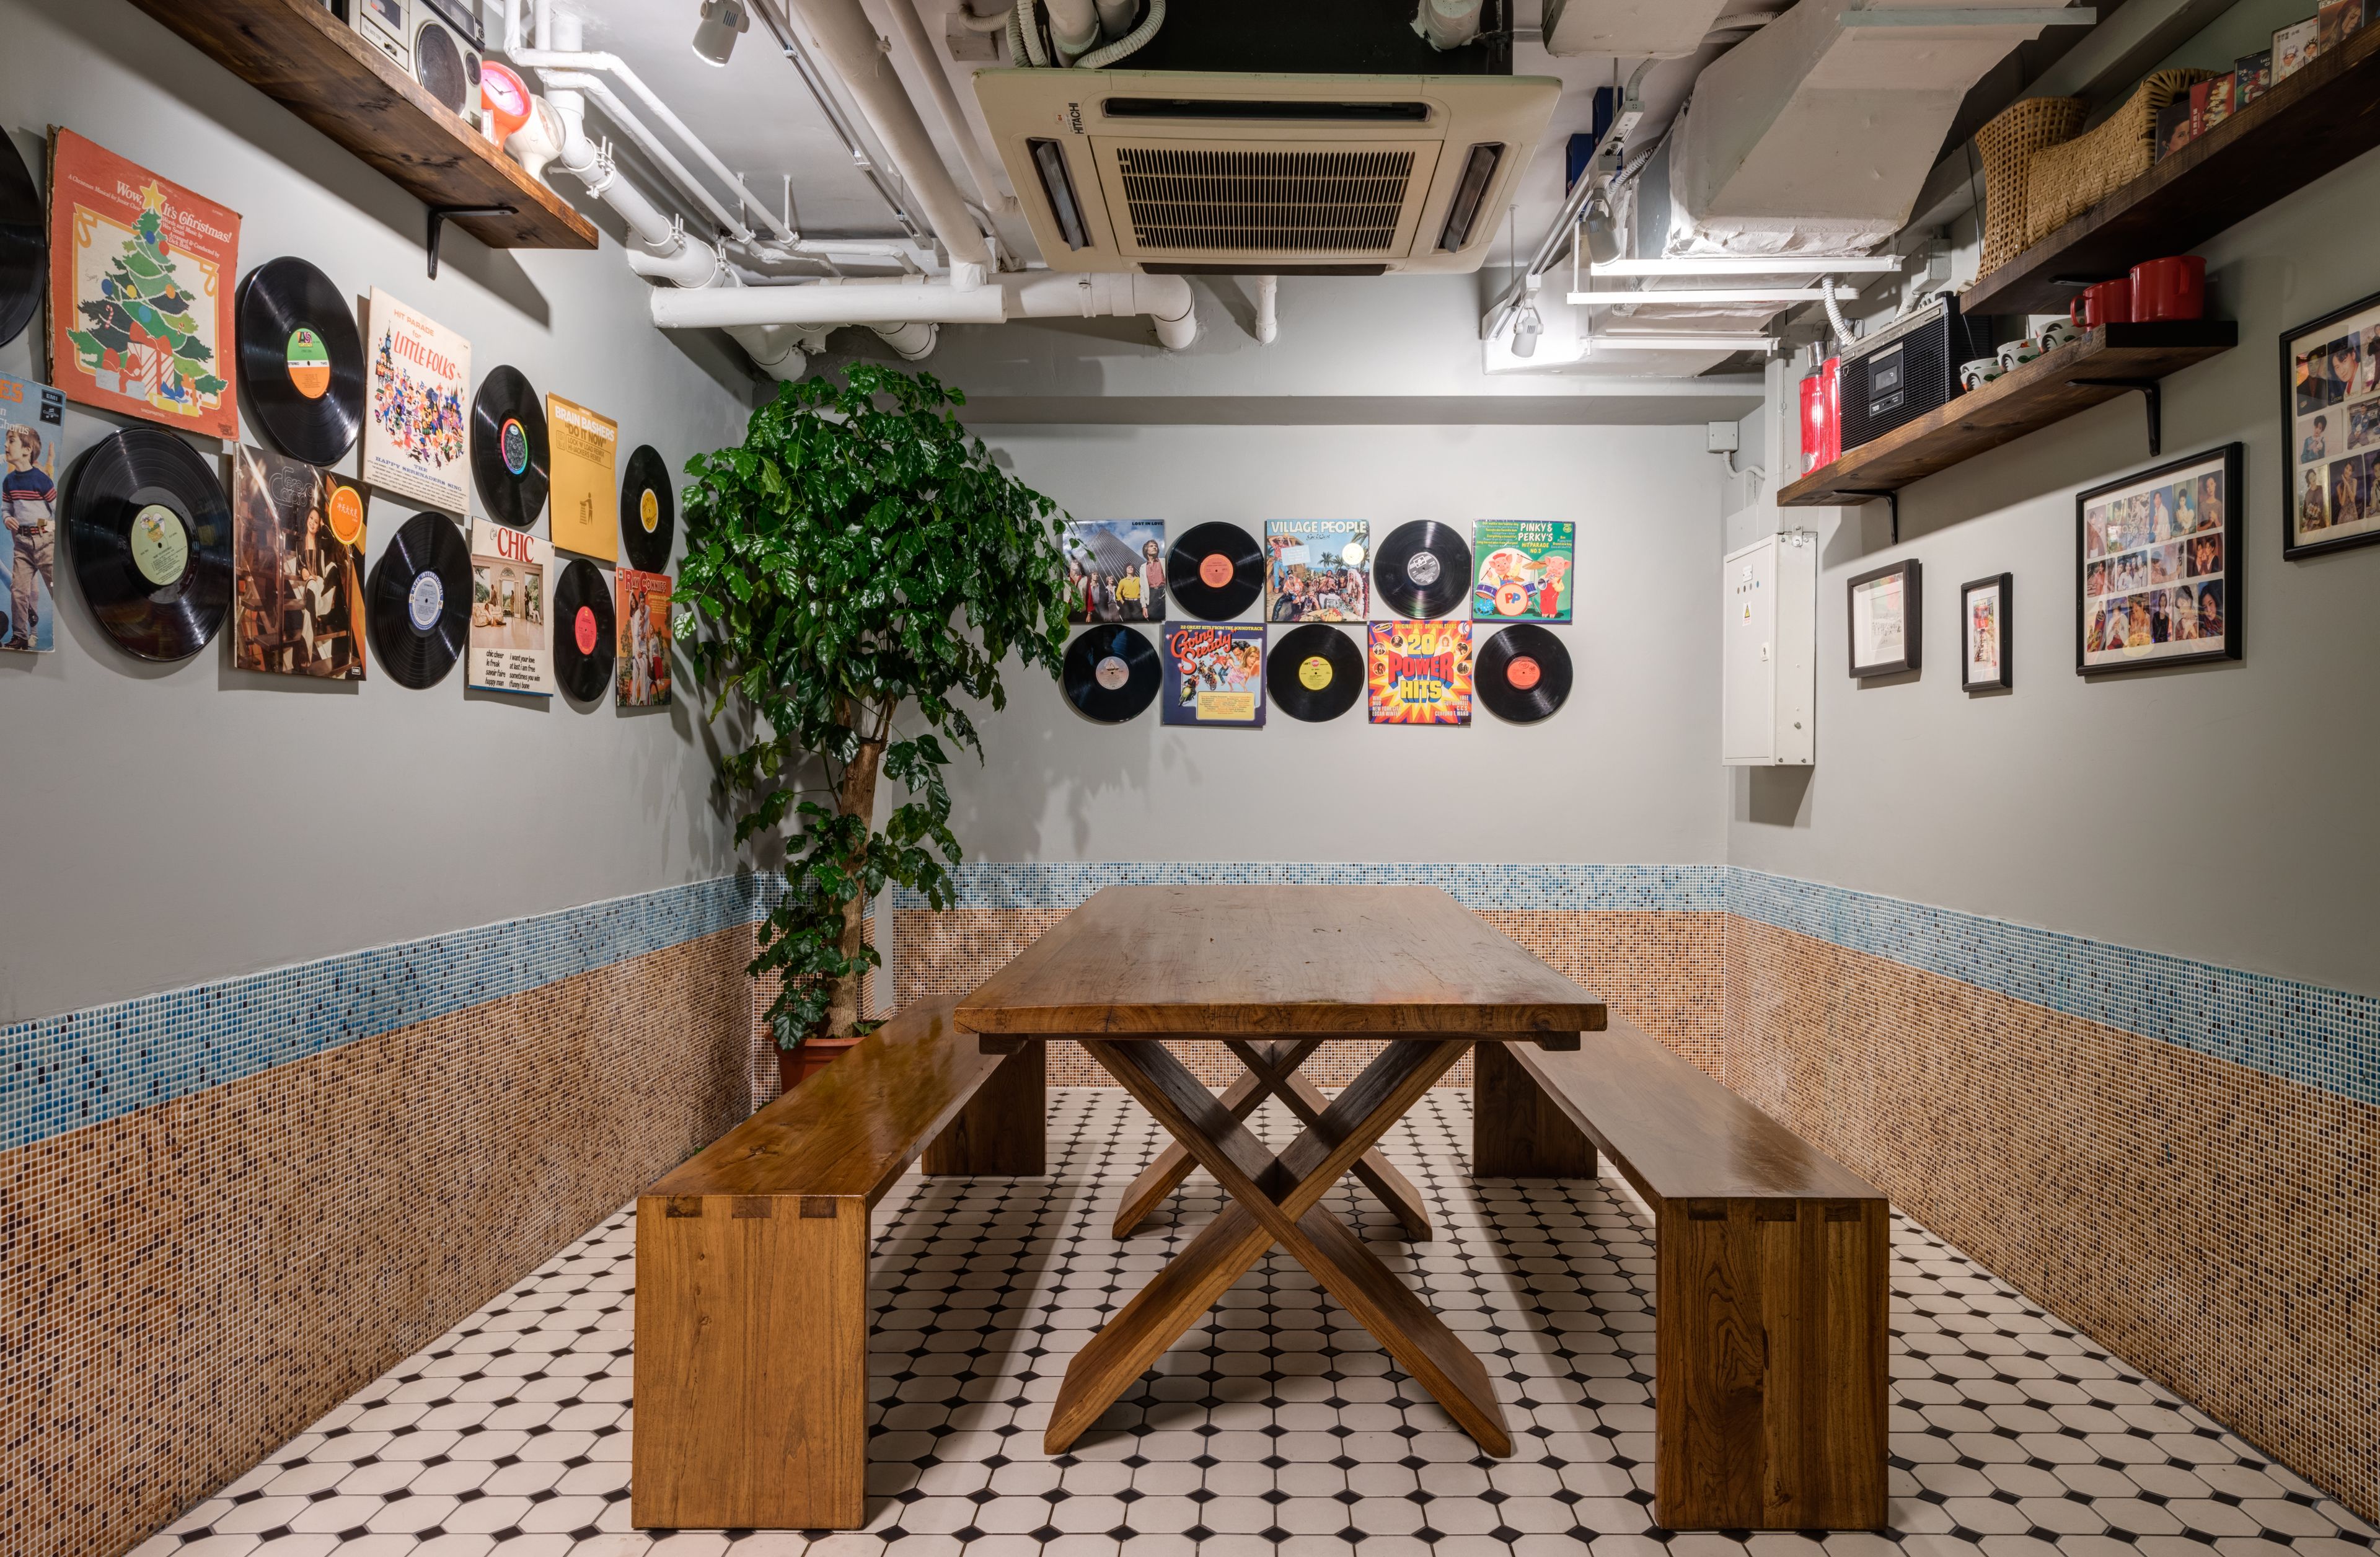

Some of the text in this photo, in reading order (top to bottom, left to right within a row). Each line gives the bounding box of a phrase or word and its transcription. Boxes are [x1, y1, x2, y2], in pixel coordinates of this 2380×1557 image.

[1069, 103, 1084, 134] HITACHI
[73, 175, 94, 190] Christmas
[94, 186, 111, 198] Musical
[117, 180, 143, 205] Wow,
[162, 203, 232, 243] It's Christmas!
[162, 216, 176, 227] Words
[185, 226, 198, 236] Music
[172, 227, 185, 236] Smith
[169, 232, 189, 244] Arranged
[194, 242, 214, 255] Conducted
[214, 250, 221, 258] by
[394, 309, 434, 337] HIT PARADE
[412, 330, 421, 340] for
[394, 331, 456, 380] LITTLE FOLKS
[46, 393, 58, 401] EMI
[555, 405, 581, 427] BRAIN
[581, 416, 615, 442] BASHERS
[581, 428, 588, 440] IT
[568, 437, 578, 446] LOCK
[584, 443, 594, 452] LOAD
[593, 446, 605, 457] REMIX
[414, 464, 428, 472] THE
[589, 453, 602, 463] REMIX
[376, 456, 462, 492] HAPPY SERENADERS SING
[1271, 521, 1367, 534] VILLAGE PEOPLE
[1518, 532, 1553, 542] PERKY'S
[1520, 523, 1546, 532] PINKY
[1547, 523, 1553, 532] &
[498, 527, 534, 563] CHIC
[421, 571, 444, 596] INTERNATIONAL
[625, 570, 666, 594] RAY CONNIFF
[494, 650, 504, 658] cheer
[1408, 633, 1435, 656] 20
[496, 669, 506, 677] faire
[509, 673, 527, 681] sometimes
[1388, 650, 1455, 687] POWER
[485, 677, 496, 687] happy
[509, 680, 530, 690] (funny) bone
[1401, 680, 1442, 702] HITS
